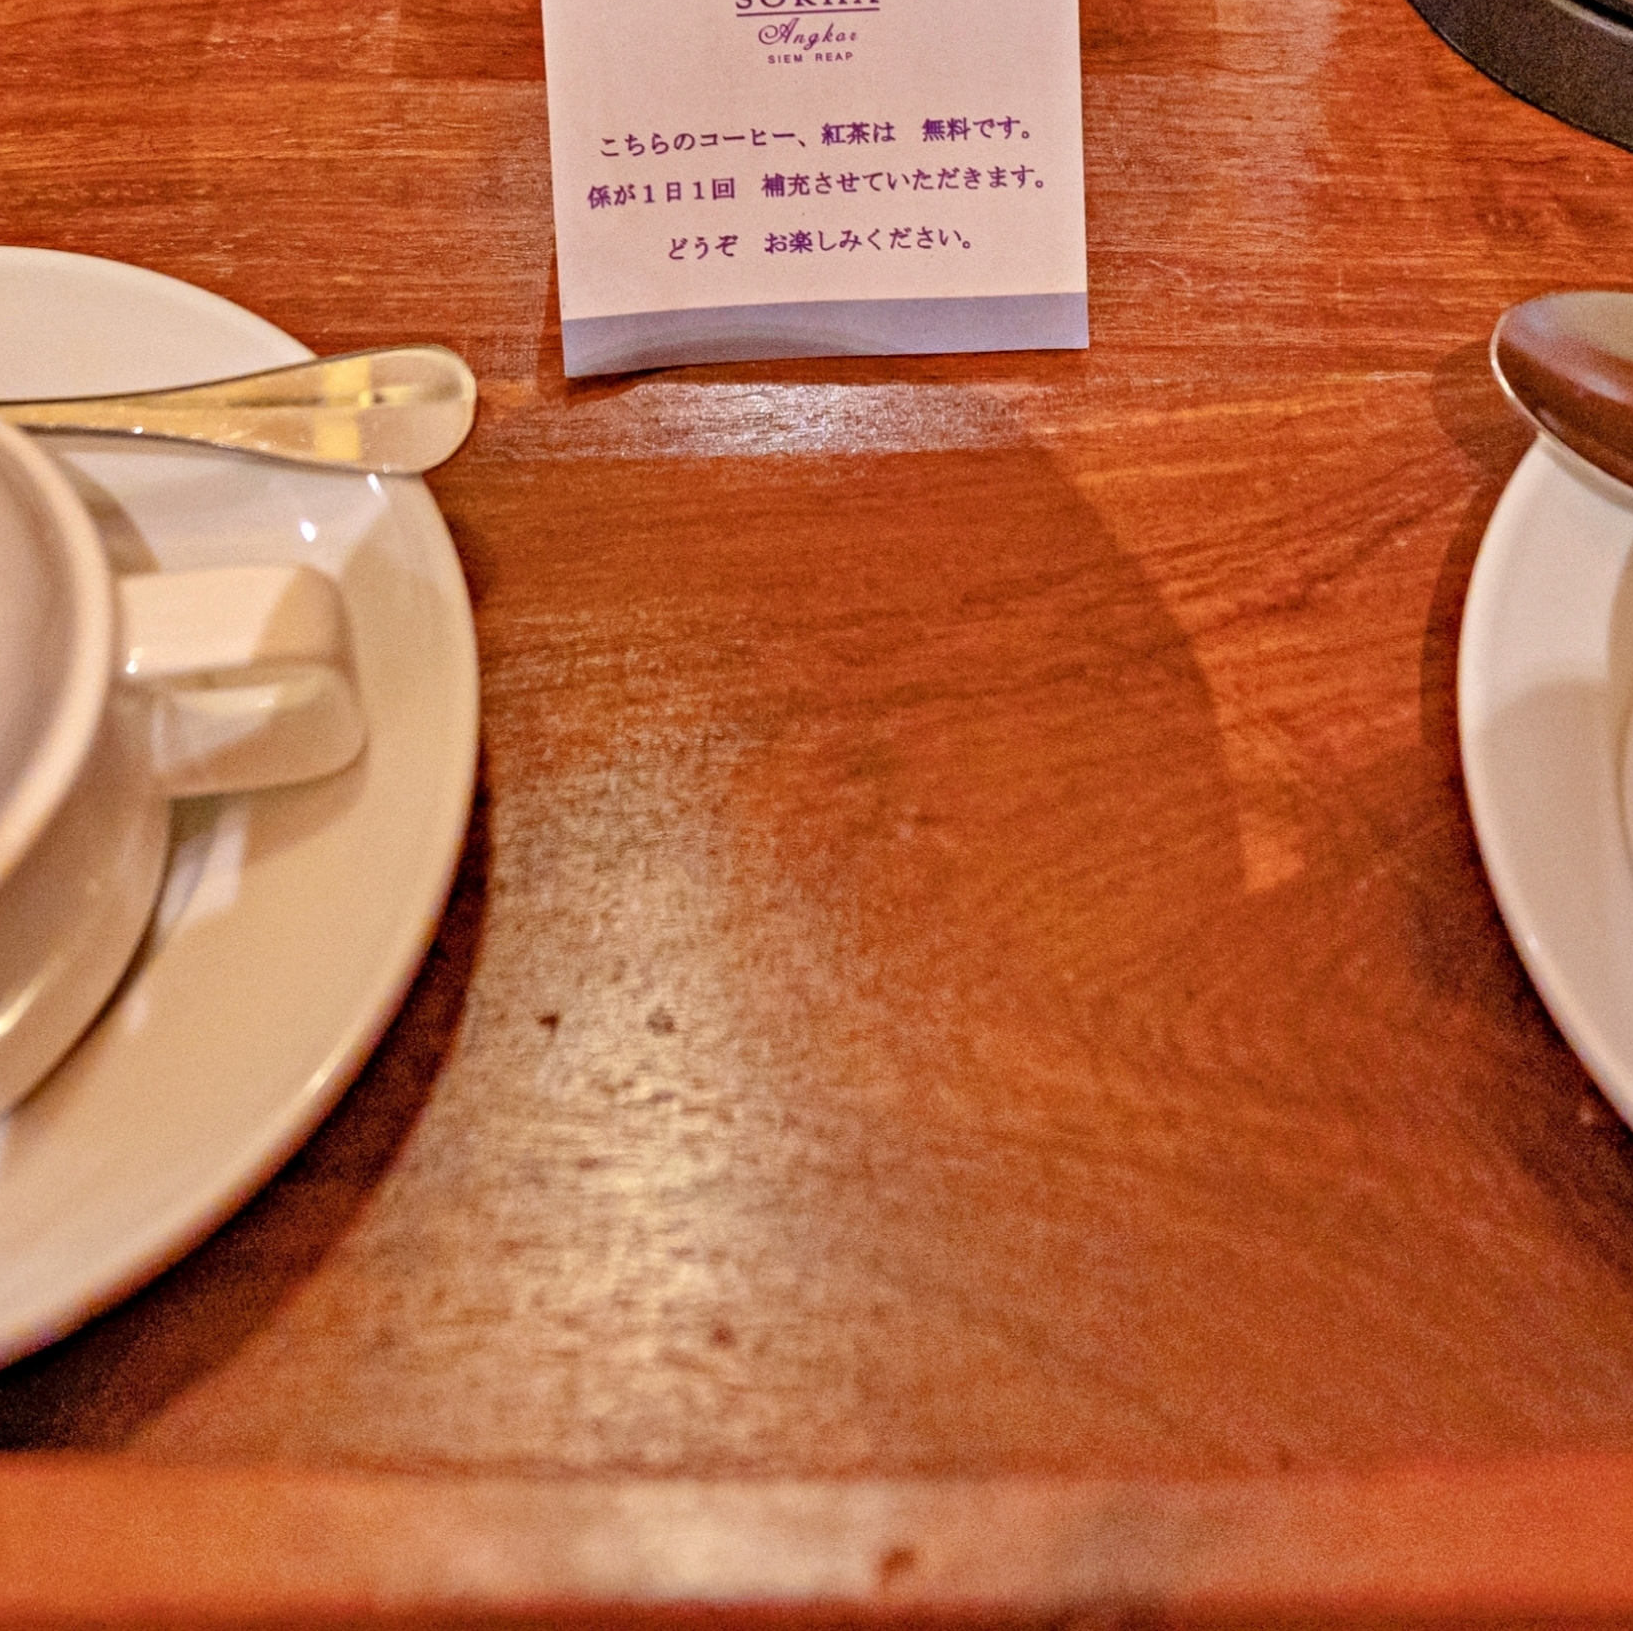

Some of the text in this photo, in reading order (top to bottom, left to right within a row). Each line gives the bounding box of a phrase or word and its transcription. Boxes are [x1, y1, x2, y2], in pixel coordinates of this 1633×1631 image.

[758, 17, 857, 51] Angkor
[767, 51, 854, 64] SIEM REAP
[600, 115, 1031, 157] こちらのコーヒー、紅茶は 無料です。
[761, 164, 1045, 198] 補充させていただきます。
[668, 226, 972, 260] どうぞ お楽しみください。
